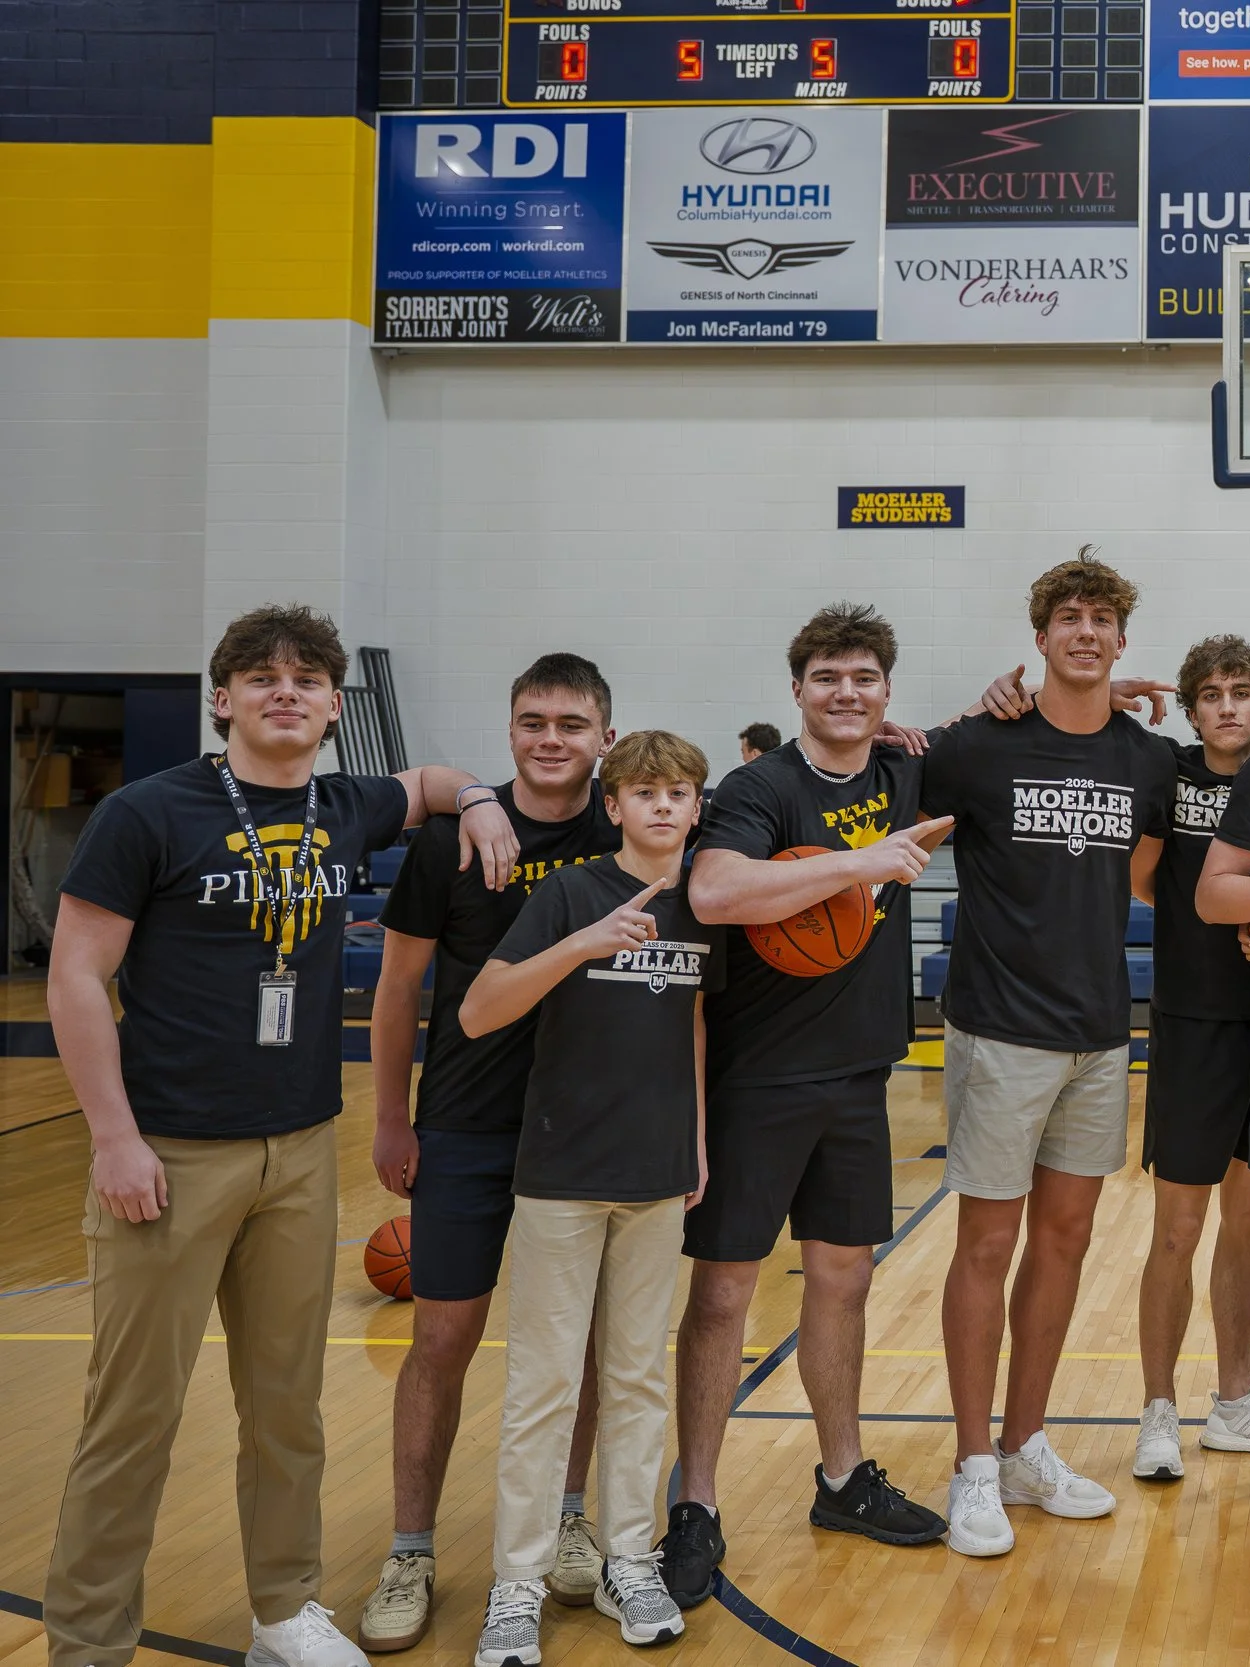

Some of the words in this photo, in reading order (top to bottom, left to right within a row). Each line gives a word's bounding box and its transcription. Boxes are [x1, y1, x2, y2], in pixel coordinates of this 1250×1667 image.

[539, 24, 590, 41] FOULS
[929, 20, 982, 37] FOULS
[562, 42, 585, 80] 0
[677, 41, 701, 79] 5
[716, 43, 798, 61] TIMEOUTS
[811, 39, 835, 78] 5
[954, 38, 977, 77] 0
[736, 62, 775, 78] LEFT
[1185, 57, 1209, 68] See
[1212, 56, 1241, 68] how.
[535, 84, 588, 100] POINTS
[795, 82, 848, 97] MATCH
[928, 81, 982, 96] POINTS
[415, 123, 589, 178] RDI
[907, 172, 1117, 201] EXECUTIVE
[681, 185, 830, 207] HYUNDAI
[416, 201, 507, 220] Winning
[514, 201, 584, 218] Smart.
[677, 209, 832, 223] ColumbiaHyundai.com
[906, 206, 951, 215] SHUTTLE
[968, 205, 1054, 214] TRANSPORTATION
[1069, 204, 1116, 213] CHARTER
[412, 240, 491, 254] rdicorp.com
[502, 240, 585, 252] workrdi.com
[388, 271, 424, 280] PROUD
[426, 270, 485, 280] SUPPORTER
[487, 270, 501, 280] OF
[504, 270, 551, 280] MOELLER
[554, 270, 608, 280] ATHLETICS
[894, 258, 1129, 282] VONDERHAAR'S
[680, 291, 723, 300] GENESIS
[725, 291, 736, 300] of
[737, 291, 766, 300] North
[767, 291, 818, 300] Cincinnati
[958, 275, 1061, 317] Catering
[385, 295, 509, 320] SORRENTO'S
[525, 293, 603, 332] Walt's
[385, 320, 452, 338] ITALIAN
[458, 320, 508, 337] JOINT
[667, 321, 697, 337] Jon
[702, 320, 794, 337] McFarland
[799, 320, 828, 336] '79
[857, 492, 946, 508] MOELLER
[851, 507, 952, 523] STUDENTS
[222, 767, 240, 798] PILLAR
[1065, 778, 1095, 789] 2026
[1013, 787, 1133, 816] MOELLER
[1013, 809, 1133, 840] SENIORS
[245, 823, 263, 857] PILLAR
[299, 832, 312, 865] PILLAR
[1071, 838, 1083, 849] M
[612, 949, 701, 975] PILLAR
[652, 975, 665, 987] M
